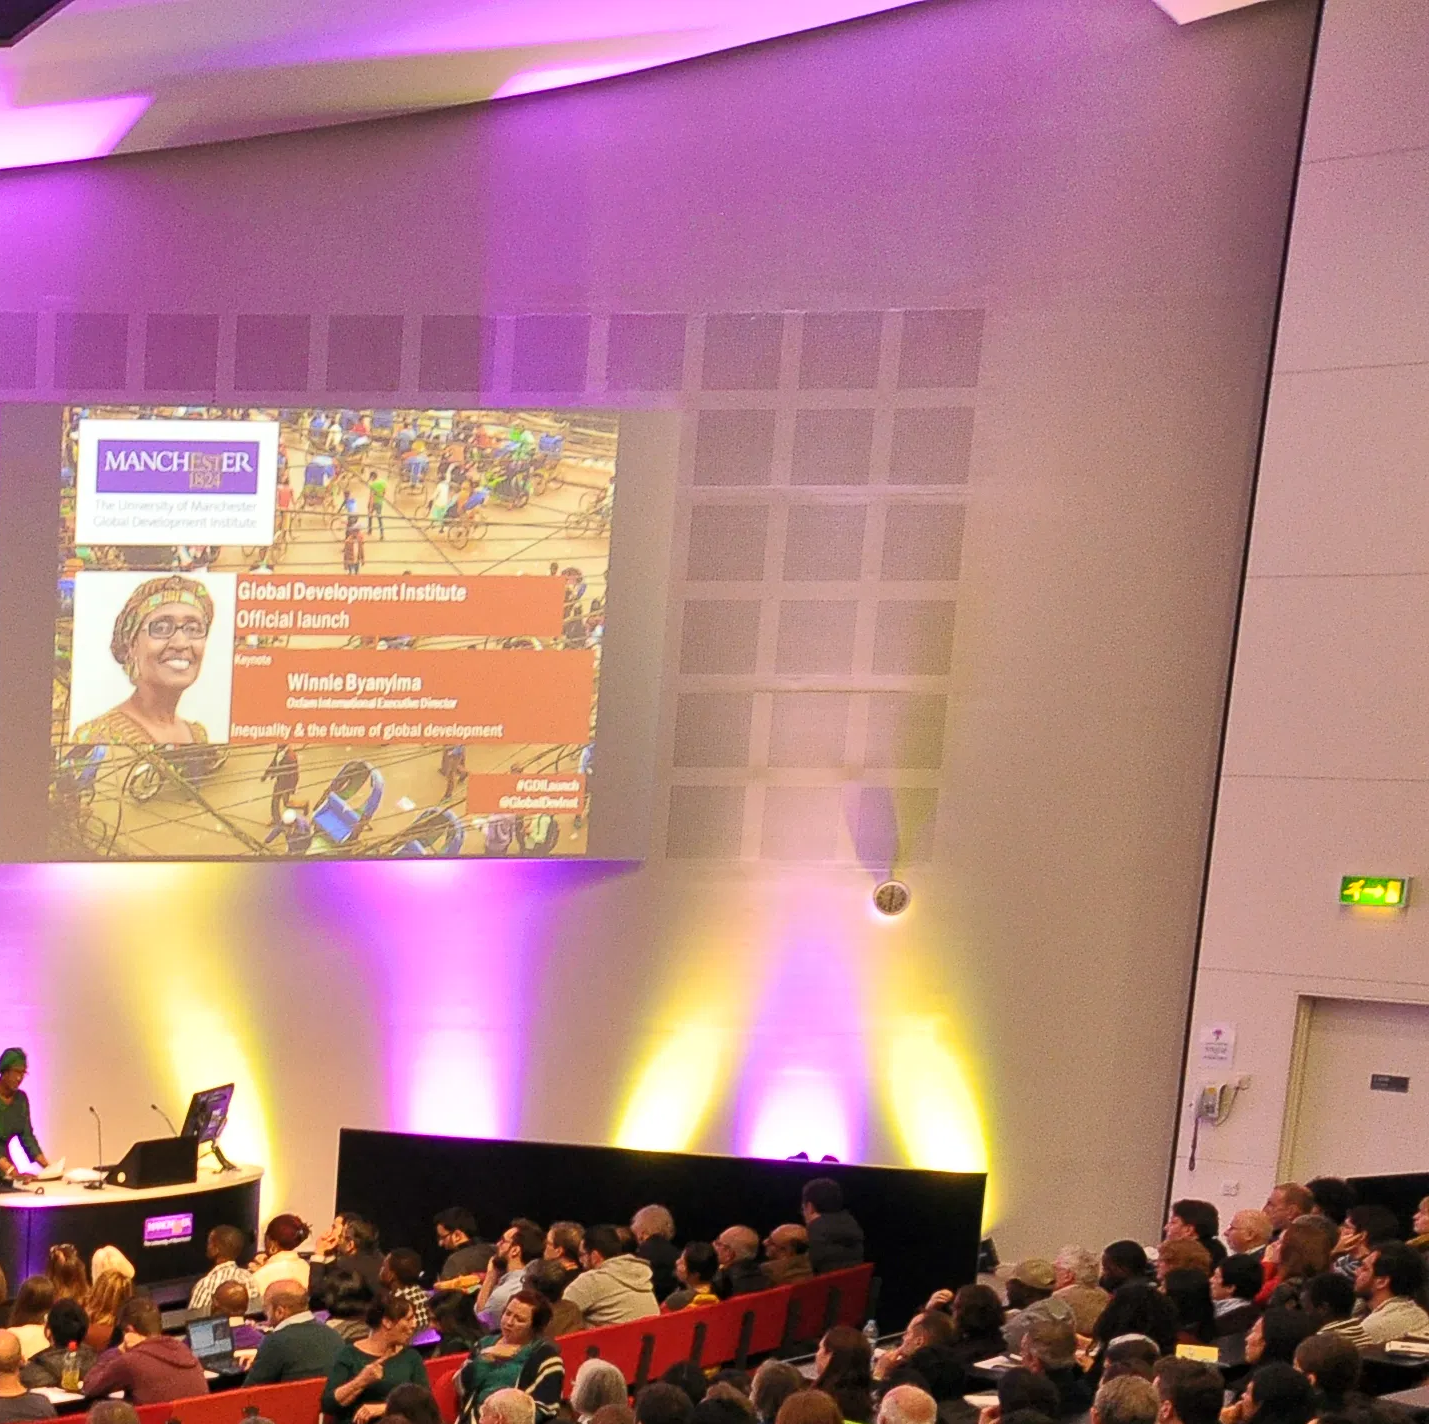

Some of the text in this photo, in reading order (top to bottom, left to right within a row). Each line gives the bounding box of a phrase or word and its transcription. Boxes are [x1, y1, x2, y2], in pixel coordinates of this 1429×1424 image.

[104, 450, 254, 473] MANCHESTER
[95, 499, 116, 511] The
[177, 500, 188, 512] of
[190, 500, 257, 513] Manchester
[93, 515, 130, 528] Global
[238, 581, 467, 604] Global Development Institute
[237, 609, 350, 630] Official launch
[287, 672, 422, 694] Winnie Byanyima
[231, 722, 503, 741] Inequality & the future of global development
